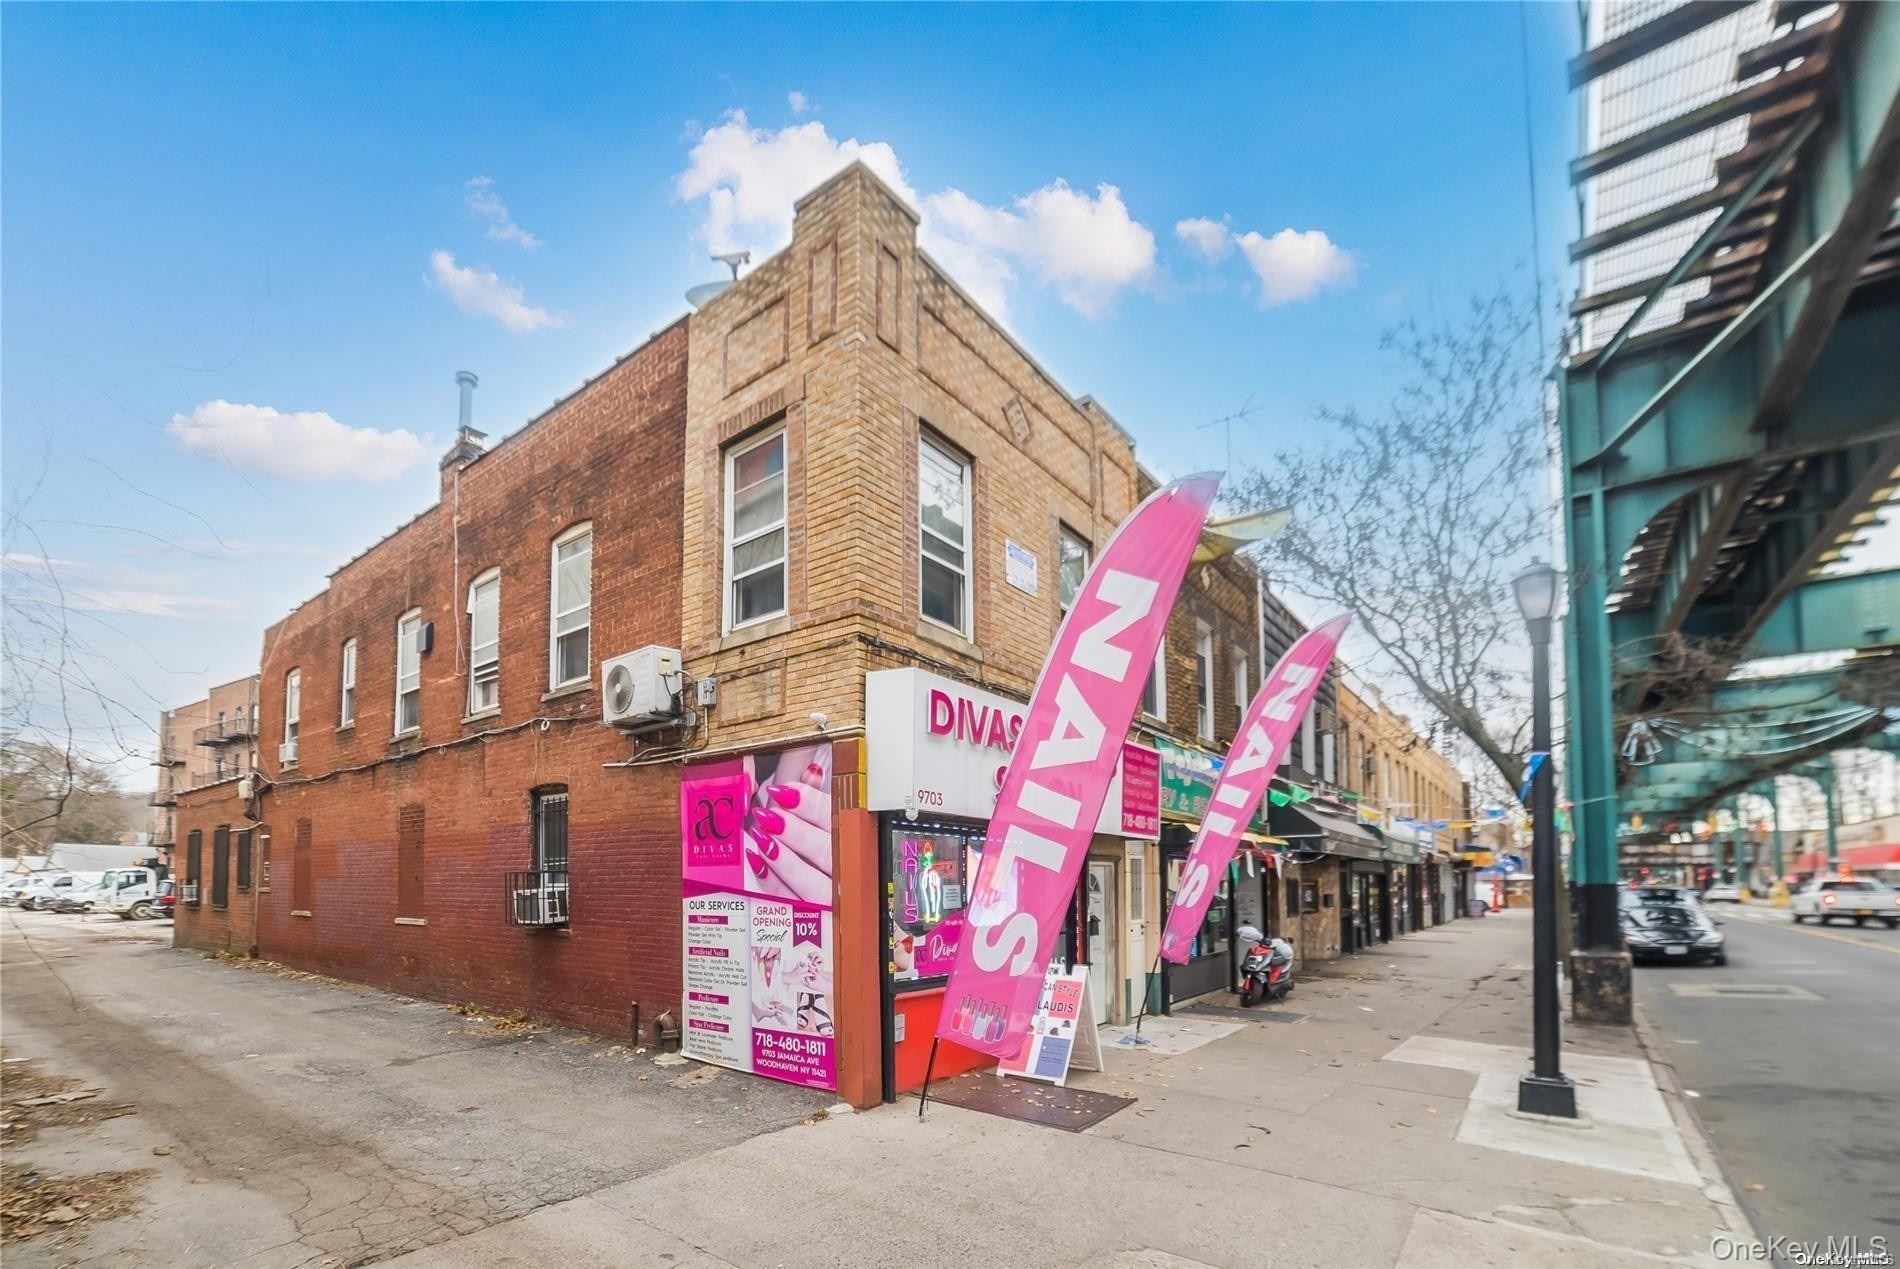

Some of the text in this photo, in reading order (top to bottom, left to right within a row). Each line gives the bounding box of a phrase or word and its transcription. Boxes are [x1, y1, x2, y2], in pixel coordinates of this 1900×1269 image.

[928, 688, 1023, 753] DIVAS
[972, 568, 1159, 977] NAILS
[1176, 663, 1318, 908] NAILS
[918, 789, 943, 806] 9703
[693, 844, 733, 854] DIVAS
[903, 840, 918, 924] NAILS
[689, 900, 745, 911] OUR SERVICES
[756, 906, 787, 916] GRAND
[752, 917, 792, 927] OPENING
[796, 922, 818, 936] 10%
[756, 929, 788, 943] Special
[1058, 984, 1079, 998] STYLE
[755, 1032, 826, 1056] 718-480-1811
[762, 1049, 820, 1066] 9703 JAMAICA AVE
[756, 1058, 799, 1072] WOODHAVEN
[800, 1066, 810, 1075] NY
